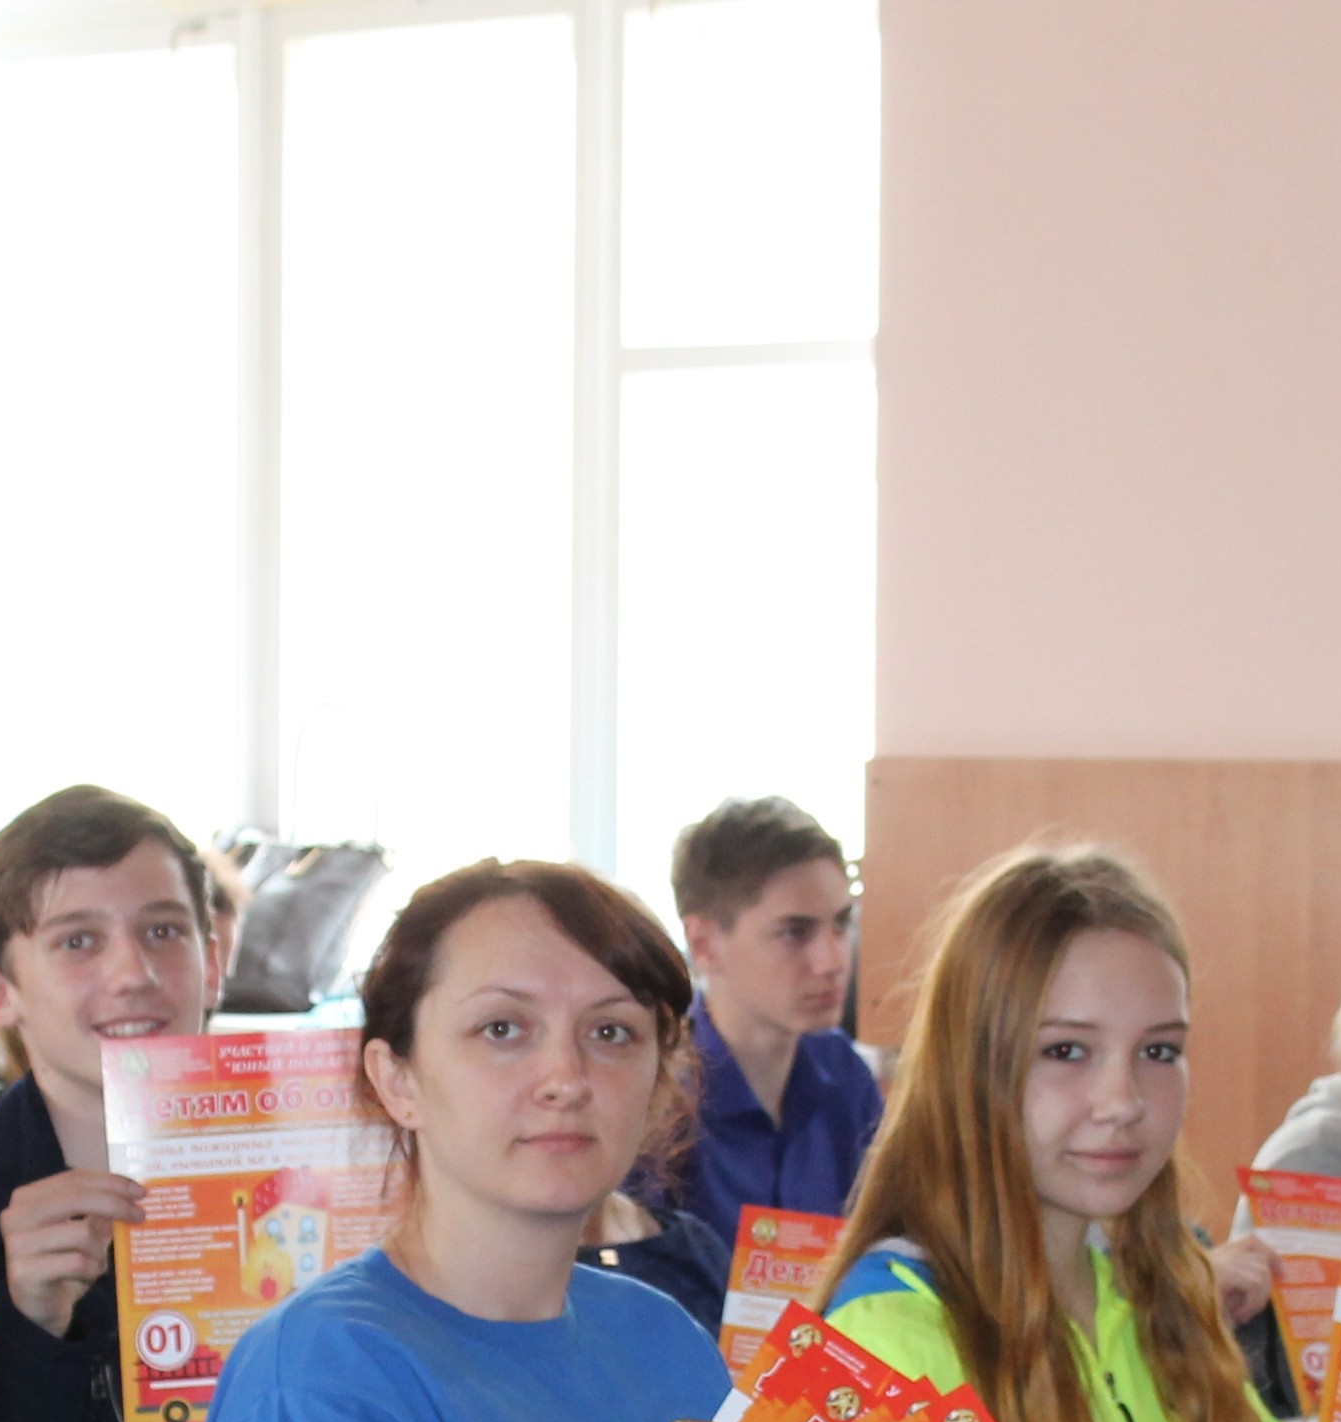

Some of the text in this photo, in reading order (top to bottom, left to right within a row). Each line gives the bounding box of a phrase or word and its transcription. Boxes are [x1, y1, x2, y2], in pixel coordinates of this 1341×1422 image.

[132, 1088, 251, 1122] етям
[256, 1081, 305, 1115] об
[146, 1324, 182, 1355] 01
